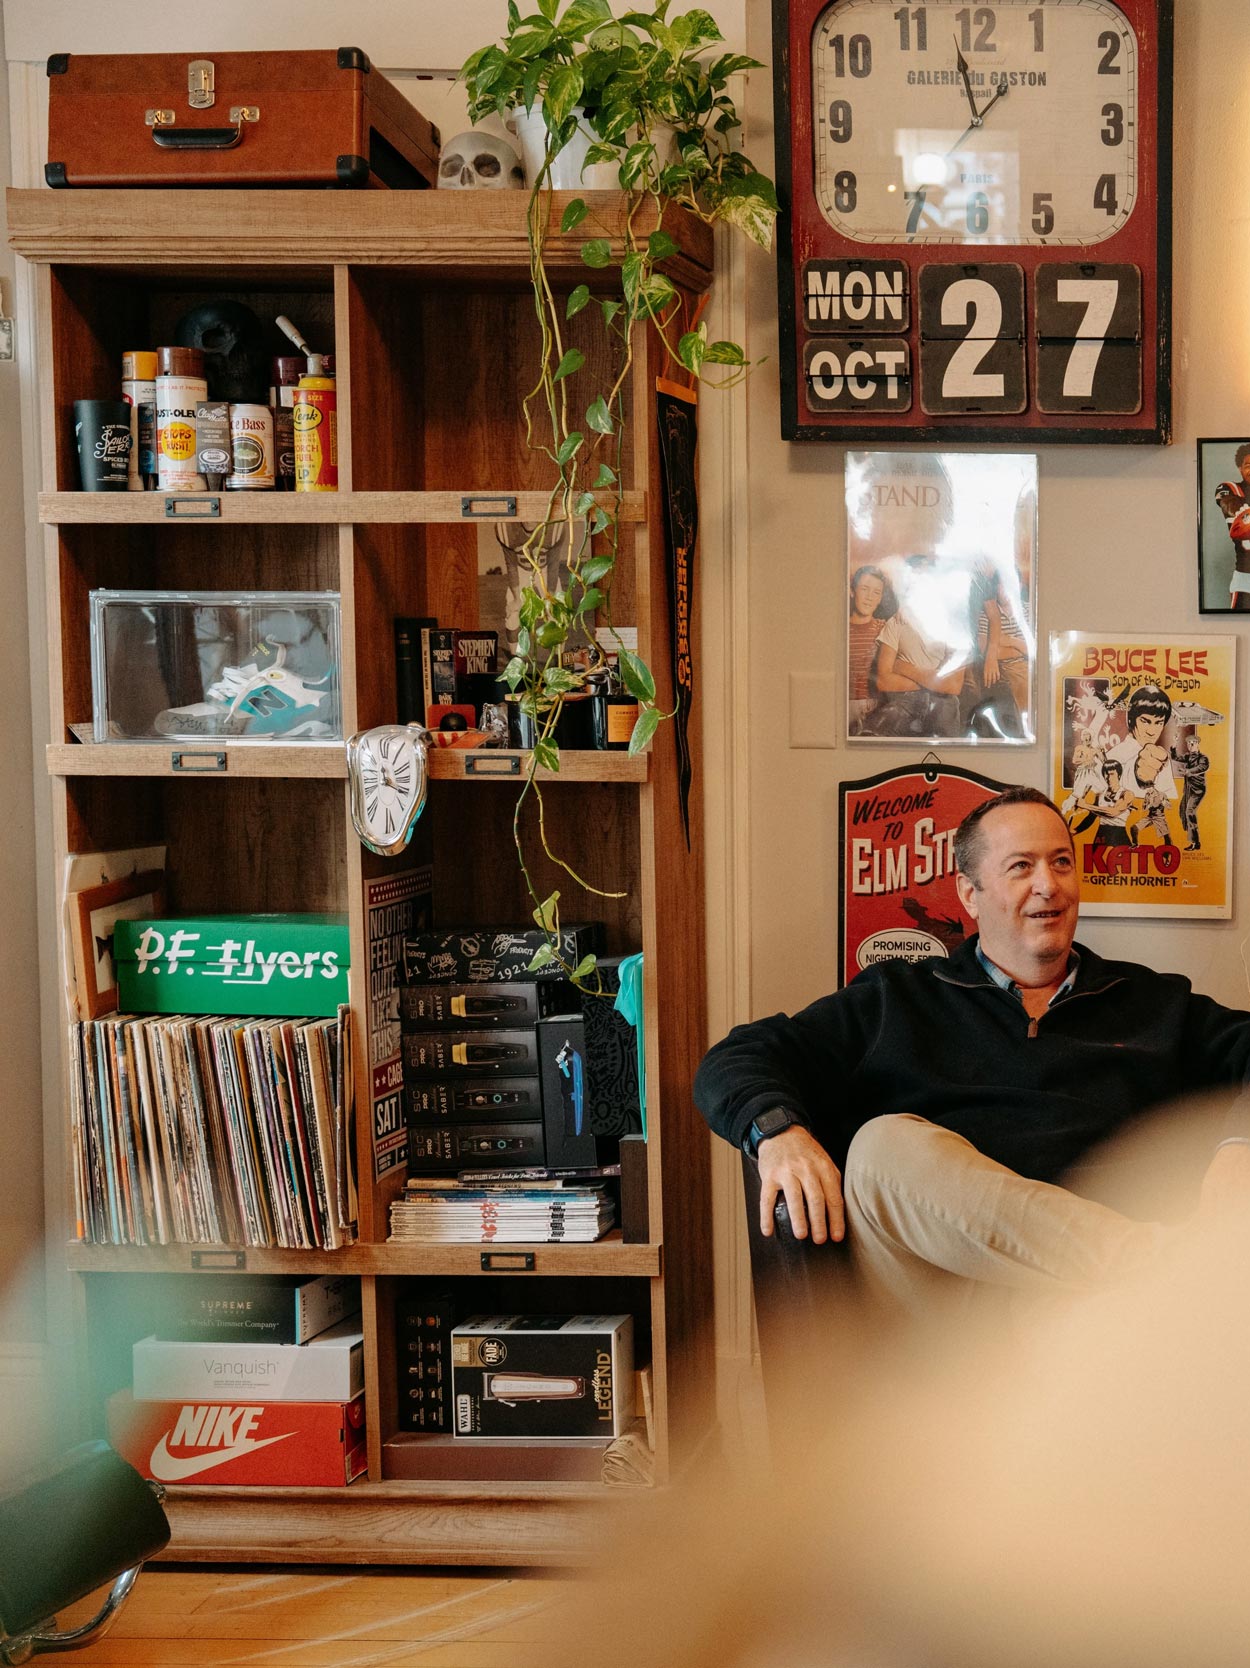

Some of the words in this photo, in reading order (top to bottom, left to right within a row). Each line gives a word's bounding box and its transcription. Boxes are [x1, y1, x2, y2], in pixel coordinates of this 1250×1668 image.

[894, 8, 927, 51] 11
[955, 8, 996, 52] 12
[1029, 9, 1044, 52] 1
[829, 34, 872, 78] 10
[1098, 31, 1121, 75] 2
[907, 70, 962, 85] GALERIE
[990, 71, 1046, 86] GASTON
[829, 100, 852, 143] 9
[1101, 103, 1123, 146] 3
[834, 171, 857, 213] 8
[960, 174, 993, 183] PARIS
[1094, 174, 1118, 216] 4
[904, 191, 927, 234] 7
[966, 191, 989, 234] 6
[1032, 193, 1054, 235] 5
[807, 271, 902, 320] MON
[809, 351, 905, 400] OCT
[157, 409, 196, 418] UST-OLEU
[242, 418, 266, 430] Bass
[164, 429, 191, 440] STOPS
[860, 485, 941, 508] TAND
[458, 639, 496, 657] STEPHEN
[1083, 647, 1157, 675] BRUCE
[1165, 648, 1209, 678] LEE
[466, 657, 489, 674] KING
[1112, 675, 1130, 688] Son
[1130, 675, 1142, 687] of
[1144, 675, 1161, 688] the
[1164, 676, 1200, 693] Dragon
[853, 788, 938, 826] WELCOME
[883, 821, 904, 842] TO
[852, 838, 908, 895] ELM
[1083, 844, 1181, 876] KATO
[1090, 875, 1128, 886] GREEN
[1130, 876, 1178, 887] HORNET
[370, 908, 384, 939] NO
[386, 901, 413, 934] OTHER
[371, 934, 401, 970] FEELIN
[873, 941, 931, 952] PROMISING
[371, 966, 397, 1001] QUITE
[407, 967, 421, 977] 21
[497, 961, 529, 980] 1921
[372, 998, 391, 1031] LIKE
[435, 995, 443, 1021] SABER
[372, 1027, 393, 1063] THIS
[377, 1097, 397, 1135] SAT
[439, 1086, 447, 1114] SABER
[443, 1132, 451, 1159] SABER
[200, 1301, 252, 1310] SUPREME
[190, 1319, 215, 1328] World's
[216, 1320, 243, 1328] Trimmer
[203, 1359, 277, 1378] Vanquish
[486, 1342, 497, 1363] FADE
[597, 1352, 612, 1421] LEGEND
[170, 1406, 264, 1447] NIKE
[460, 1398, 468, 1429] WAHL
